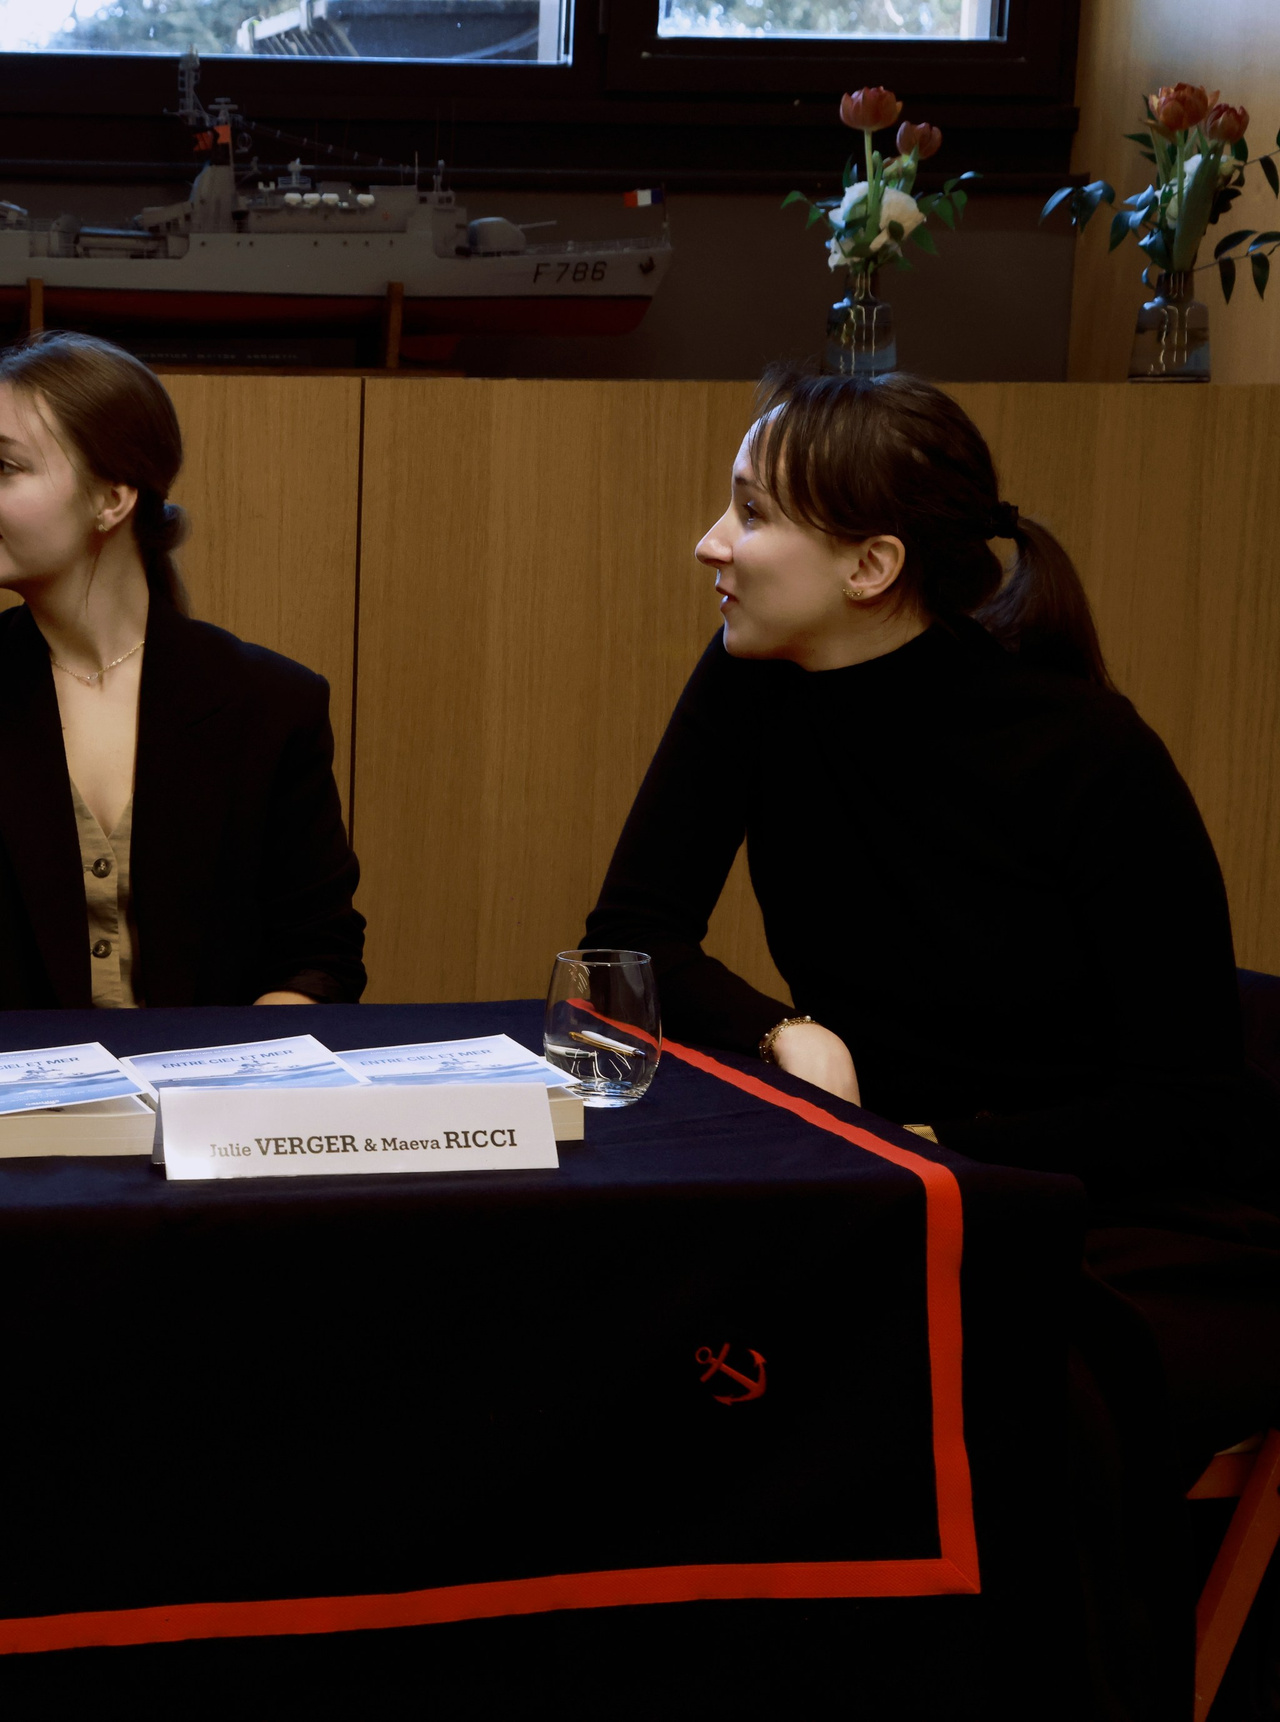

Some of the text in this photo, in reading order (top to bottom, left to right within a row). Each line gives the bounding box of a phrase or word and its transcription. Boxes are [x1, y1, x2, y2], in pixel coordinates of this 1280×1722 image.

[532, 260, 608, 284] F 786
[26, 1060, 42, 1069] ET
[46, 1056, 80, 1065] MER
[161, 1060, 207, 1069] ENTRE
[209, 1057, 237, 1065] CIEL
[240, 1054, 257, 1062] ET
[260, 1050, 293, 1058] MER
[360, 1049, 491, 1066] ENTRE CIEL ET MER
[210, 1129, 517, 1156] Julie VERGER & Maeva RICCI
